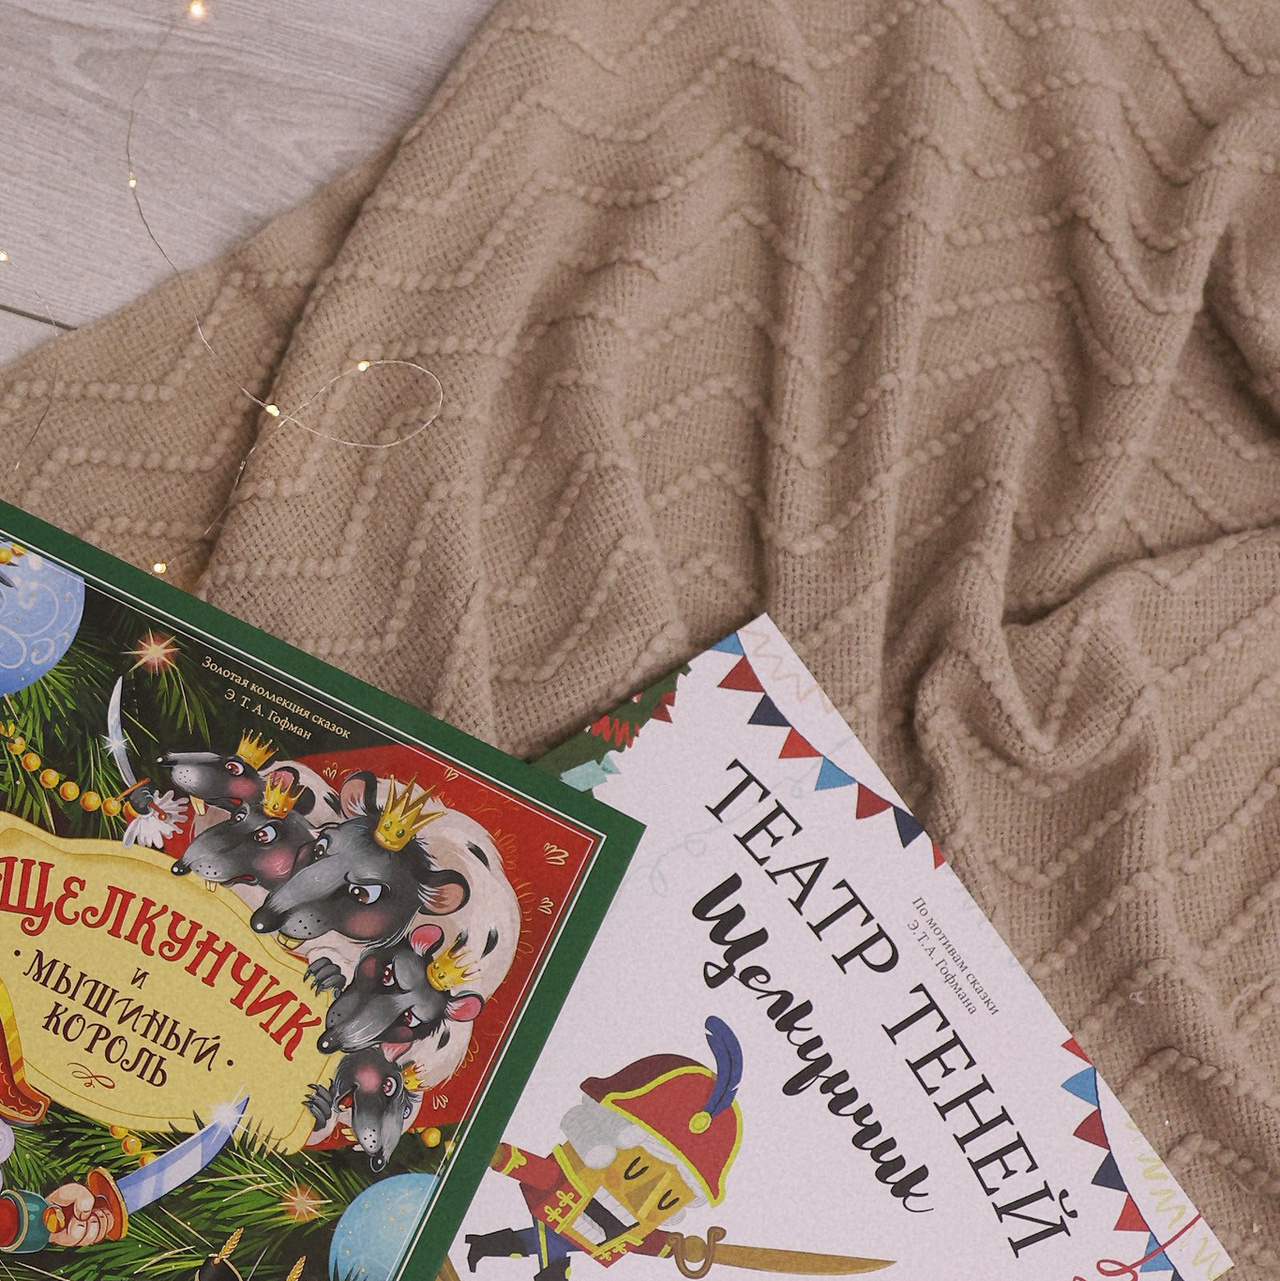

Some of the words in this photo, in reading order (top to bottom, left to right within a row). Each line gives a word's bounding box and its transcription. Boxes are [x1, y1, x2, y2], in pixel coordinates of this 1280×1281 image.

[201, 656, 249, 688] Золотая
[250, 683, 311, 719] коллекция
[312, 714, 352, 740] сказок
[224, 688, 236, 703] Э.
[240, 695, 251, 710] Т.
[252, 704, 264, 717] А.
[267, 710, 312, 740] Гофман
[912, 897, 929, 917] По
[925, 917, 968, 973] мотивам
[966, 973, 1000, 1016] сказки
[935, 958, 977, 1015] Гофмана
[23, 949, 221, 1072] МЫШИНЫЙ
[42, 1001, 169, 1088] КОРОЛЬ
[691, 872, 934, 1214] Щелкунчик
[704, 758, 900, 975] ТЕАТР
[881, 982, 1082, 1259] ТЕНЕЙ
